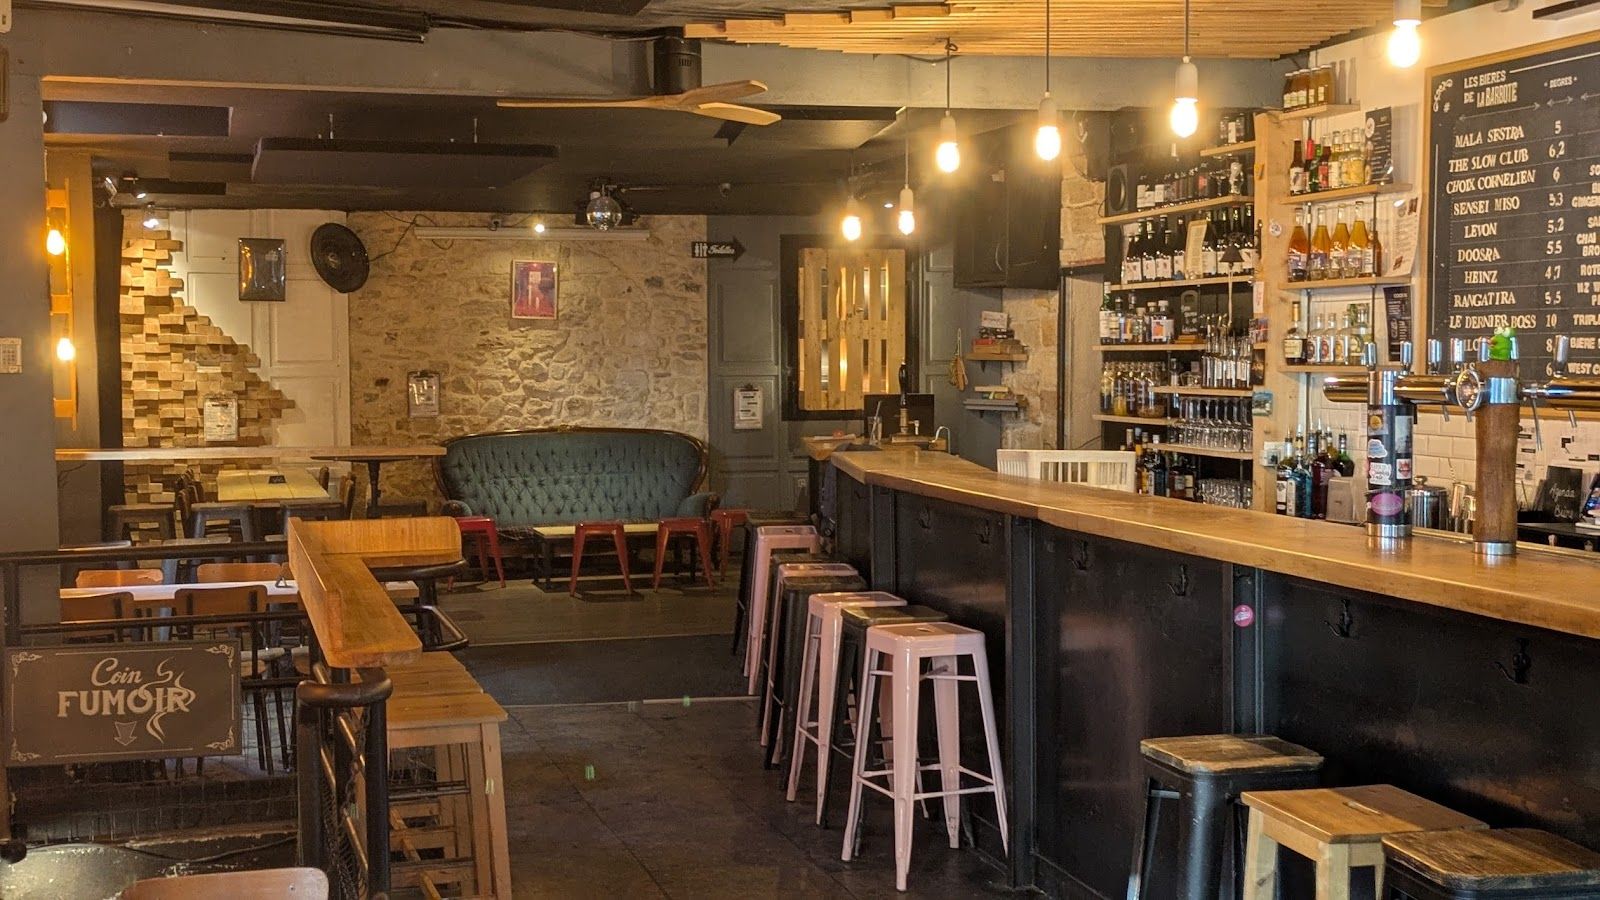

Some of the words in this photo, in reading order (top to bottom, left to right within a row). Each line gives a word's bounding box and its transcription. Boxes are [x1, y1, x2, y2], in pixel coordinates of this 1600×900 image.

[1464, 76, 1478, 89] LES
[1463, 92, 1474, 104] DE
[1476, 92, 1486, 108] LA
[1455, 131, 1483, 148] MALA
[1487, 125, 1525, 144] SESTRA
[1554, 120, 1562, 135] 5
[1448, 158, 1469, 173] THE
[1471, 154, 1497, 170] SLOW
[1499, 149, 1529, 164] CLUB
[1446, 177, 1476, 194] CHOIX
[1477, 169, 1537, 190] CORNELIEN
[1453, 201, 1490, 216] SENSEI
[1494, 196, 1520, 211] MISO
[1464, 222, 1498, 239] LEVON
[1576, 232, 1597, 245] CHAI
[1457, 247, 1501, 263] DOOSRA
[1464, 270, 1498, 284] HEINZ
[1453, 291, 1516, 308] RANGATIRA
[1449, 314, 1462, 329] LE
[1465, 313, 1509, 329] DERNIER
[1510, 314, 1537, 329] BOSS
[1545, 313, 1557, 328] 10
[1567, 362, 1592, 375] WEST
[91, 657, 142, 687] Coin
[57, 687, 193, 718] FUMOIR
